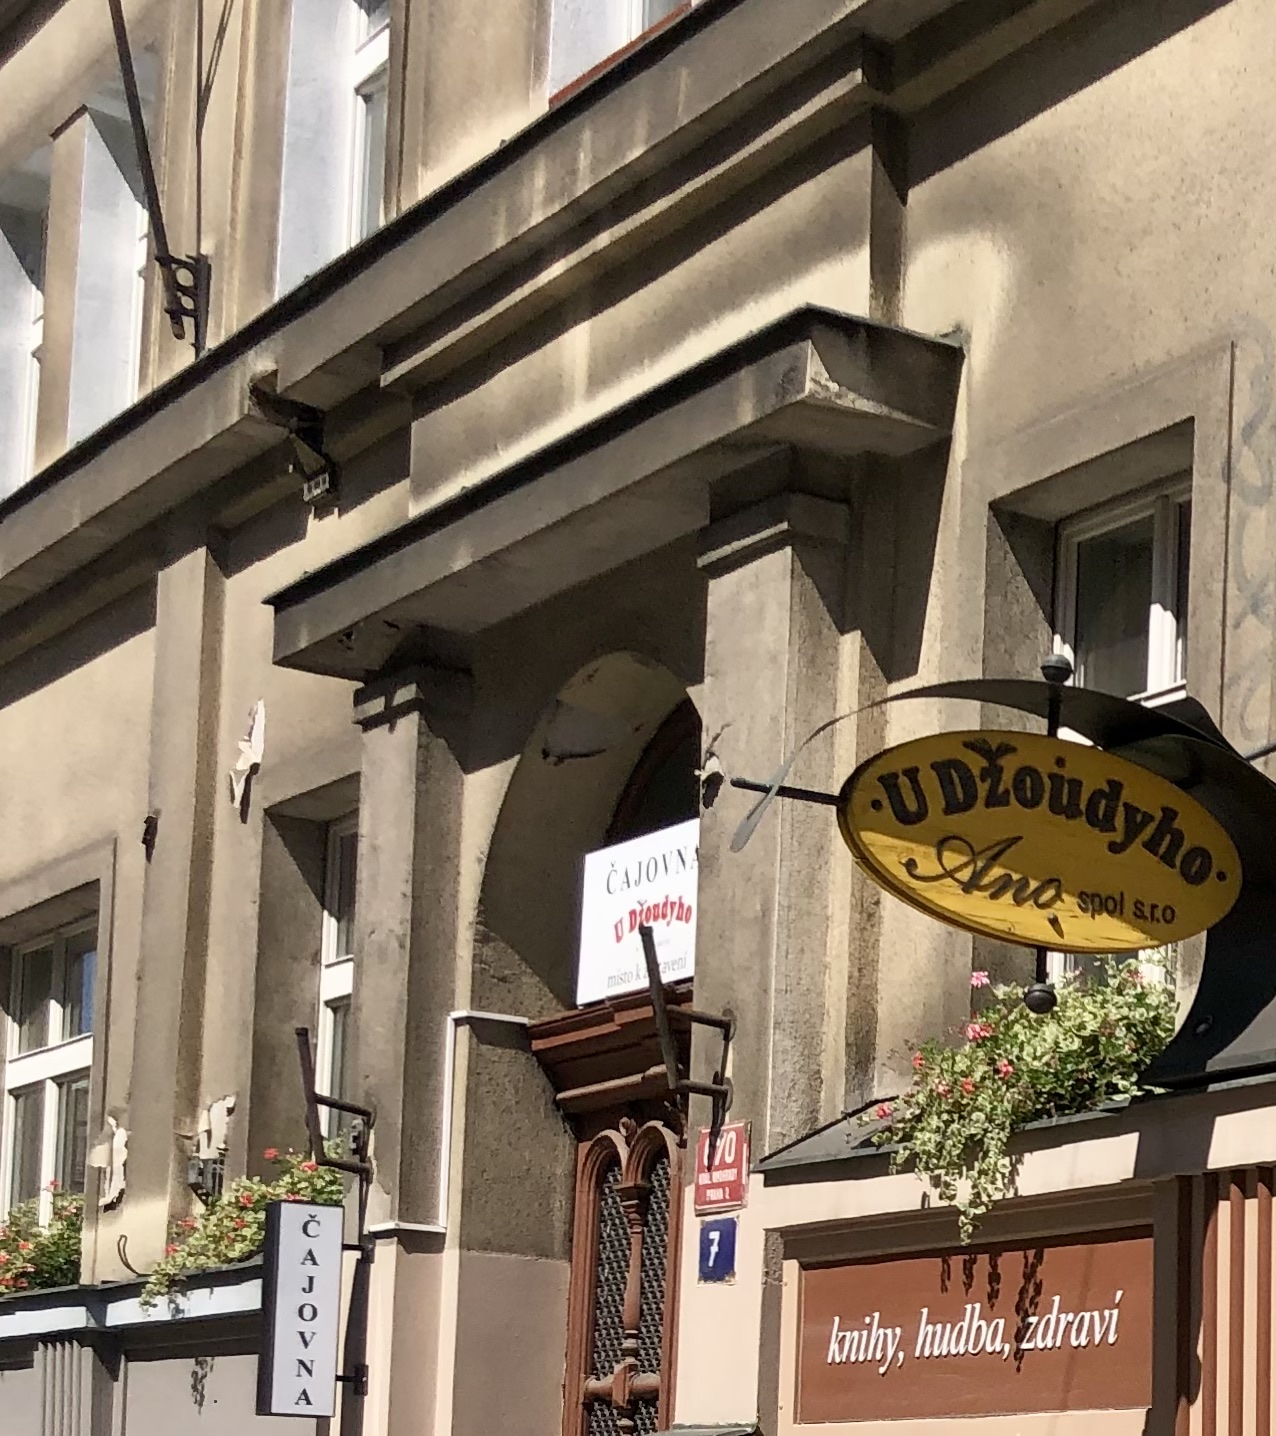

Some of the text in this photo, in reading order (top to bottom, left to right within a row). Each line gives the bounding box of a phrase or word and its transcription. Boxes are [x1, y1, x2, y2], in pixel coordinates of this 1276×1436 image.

[877, 739, 1213, 886] U Džoudyho
[614, 917, 624, 943] U
[1078, 889, 1124, 920] spol
[709, 1231, 720, 1267] 7
[294, 1213, 321, 1406] ČAJOVNA
[827, 1290, 1123, 1375] knihy, hudba, zdraví
